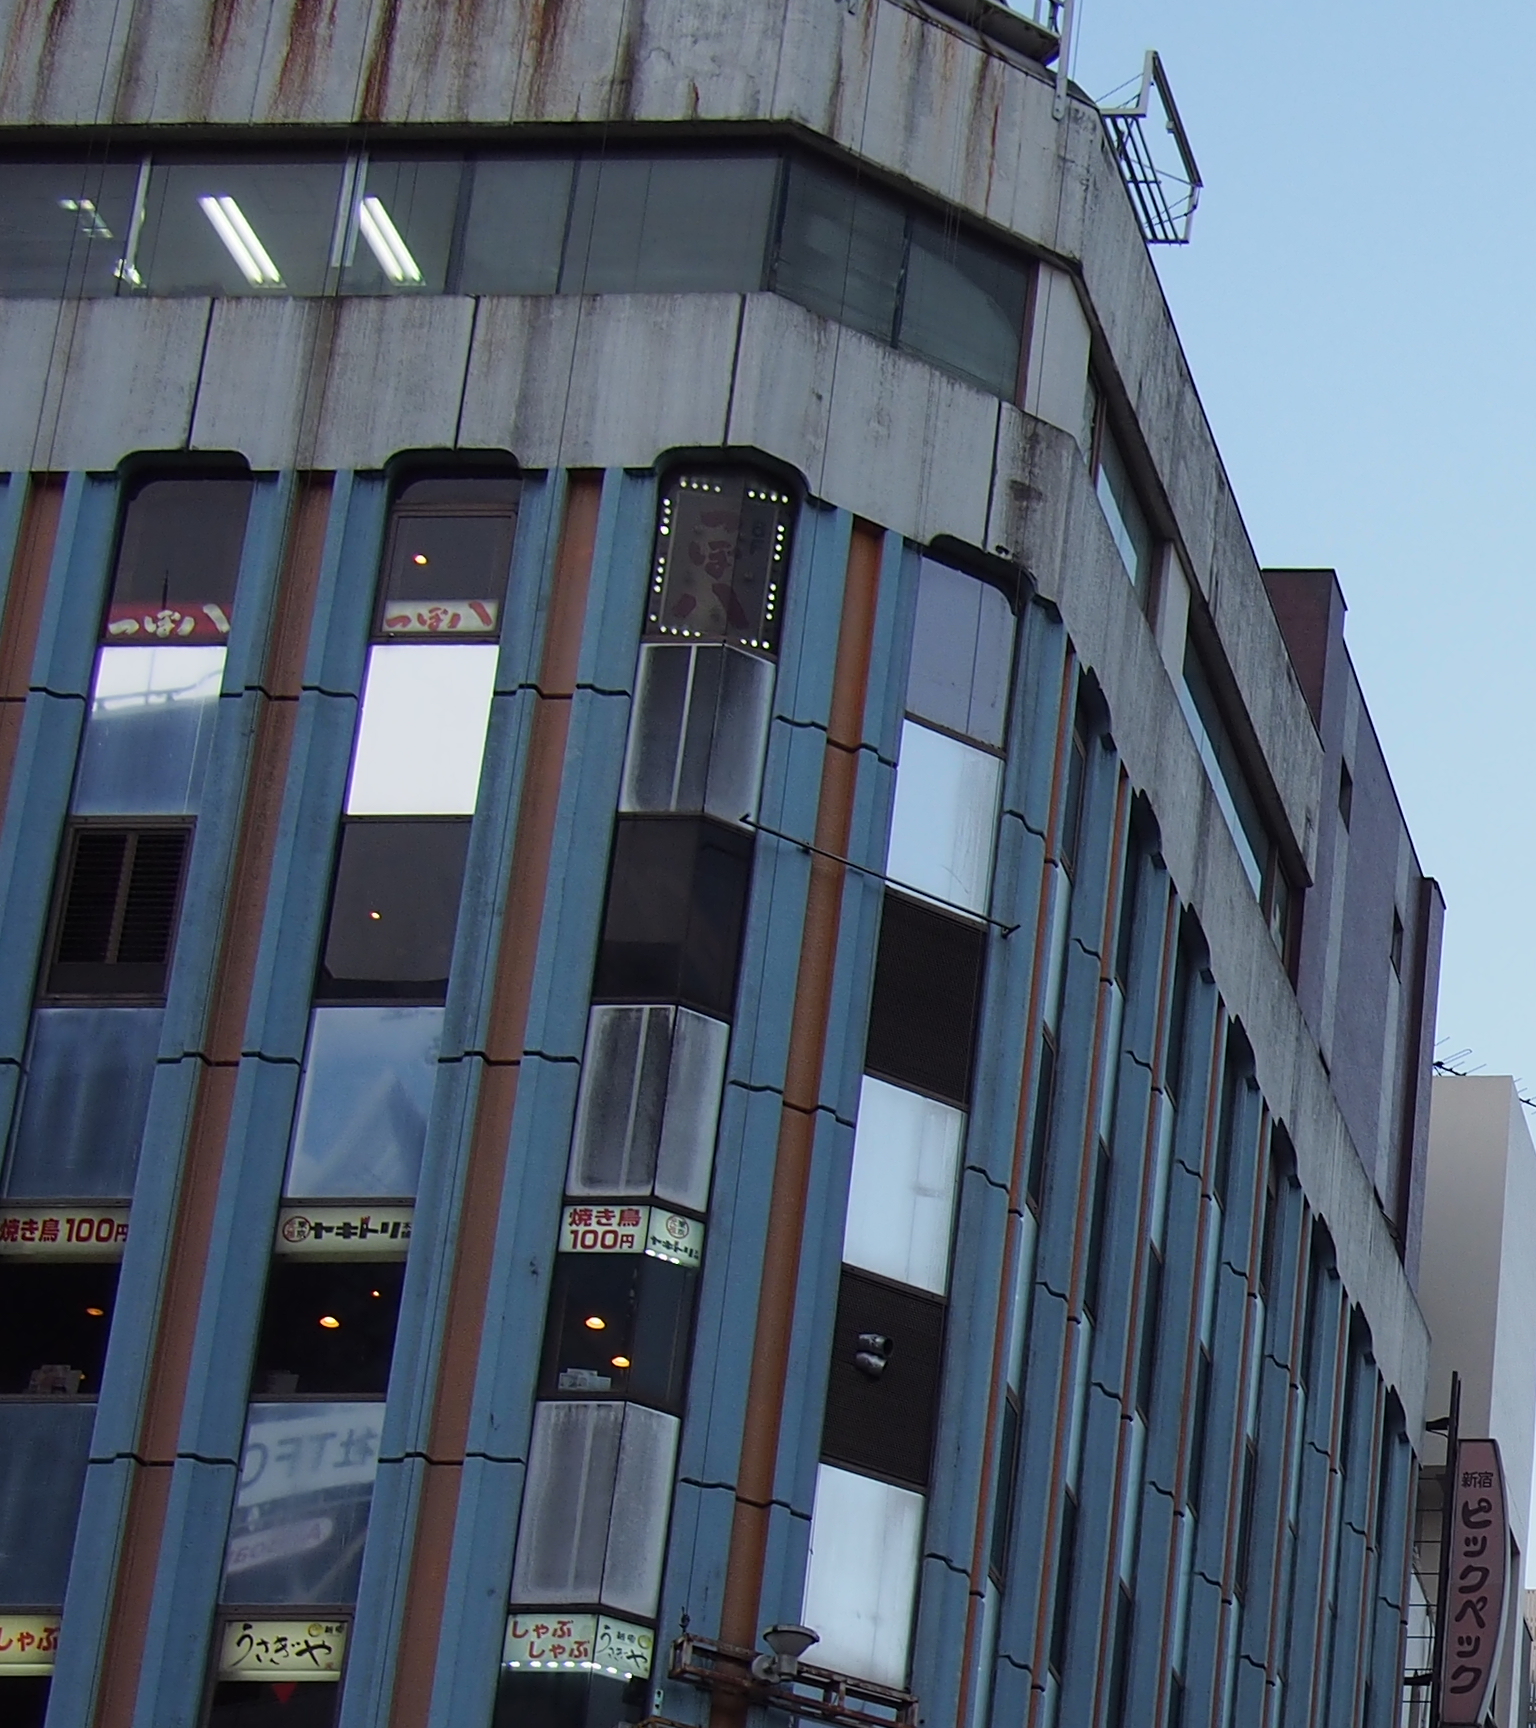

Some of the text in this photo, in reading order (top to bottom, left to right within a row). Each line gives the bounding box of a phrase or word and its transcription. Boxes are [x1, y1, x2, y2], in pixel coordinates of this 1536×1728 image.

[569, 1208, 641, 1227] 焼き鳥
[570, 1230, 635, 1249] 100円
[1461, 1470, 1494, 1489] 新宿
[512, 1620, 574, 1639] しゃぶ
[230, 1623, 332, 1667] うさぎや
[529, 1640, 590, 1659] しゃぶ
